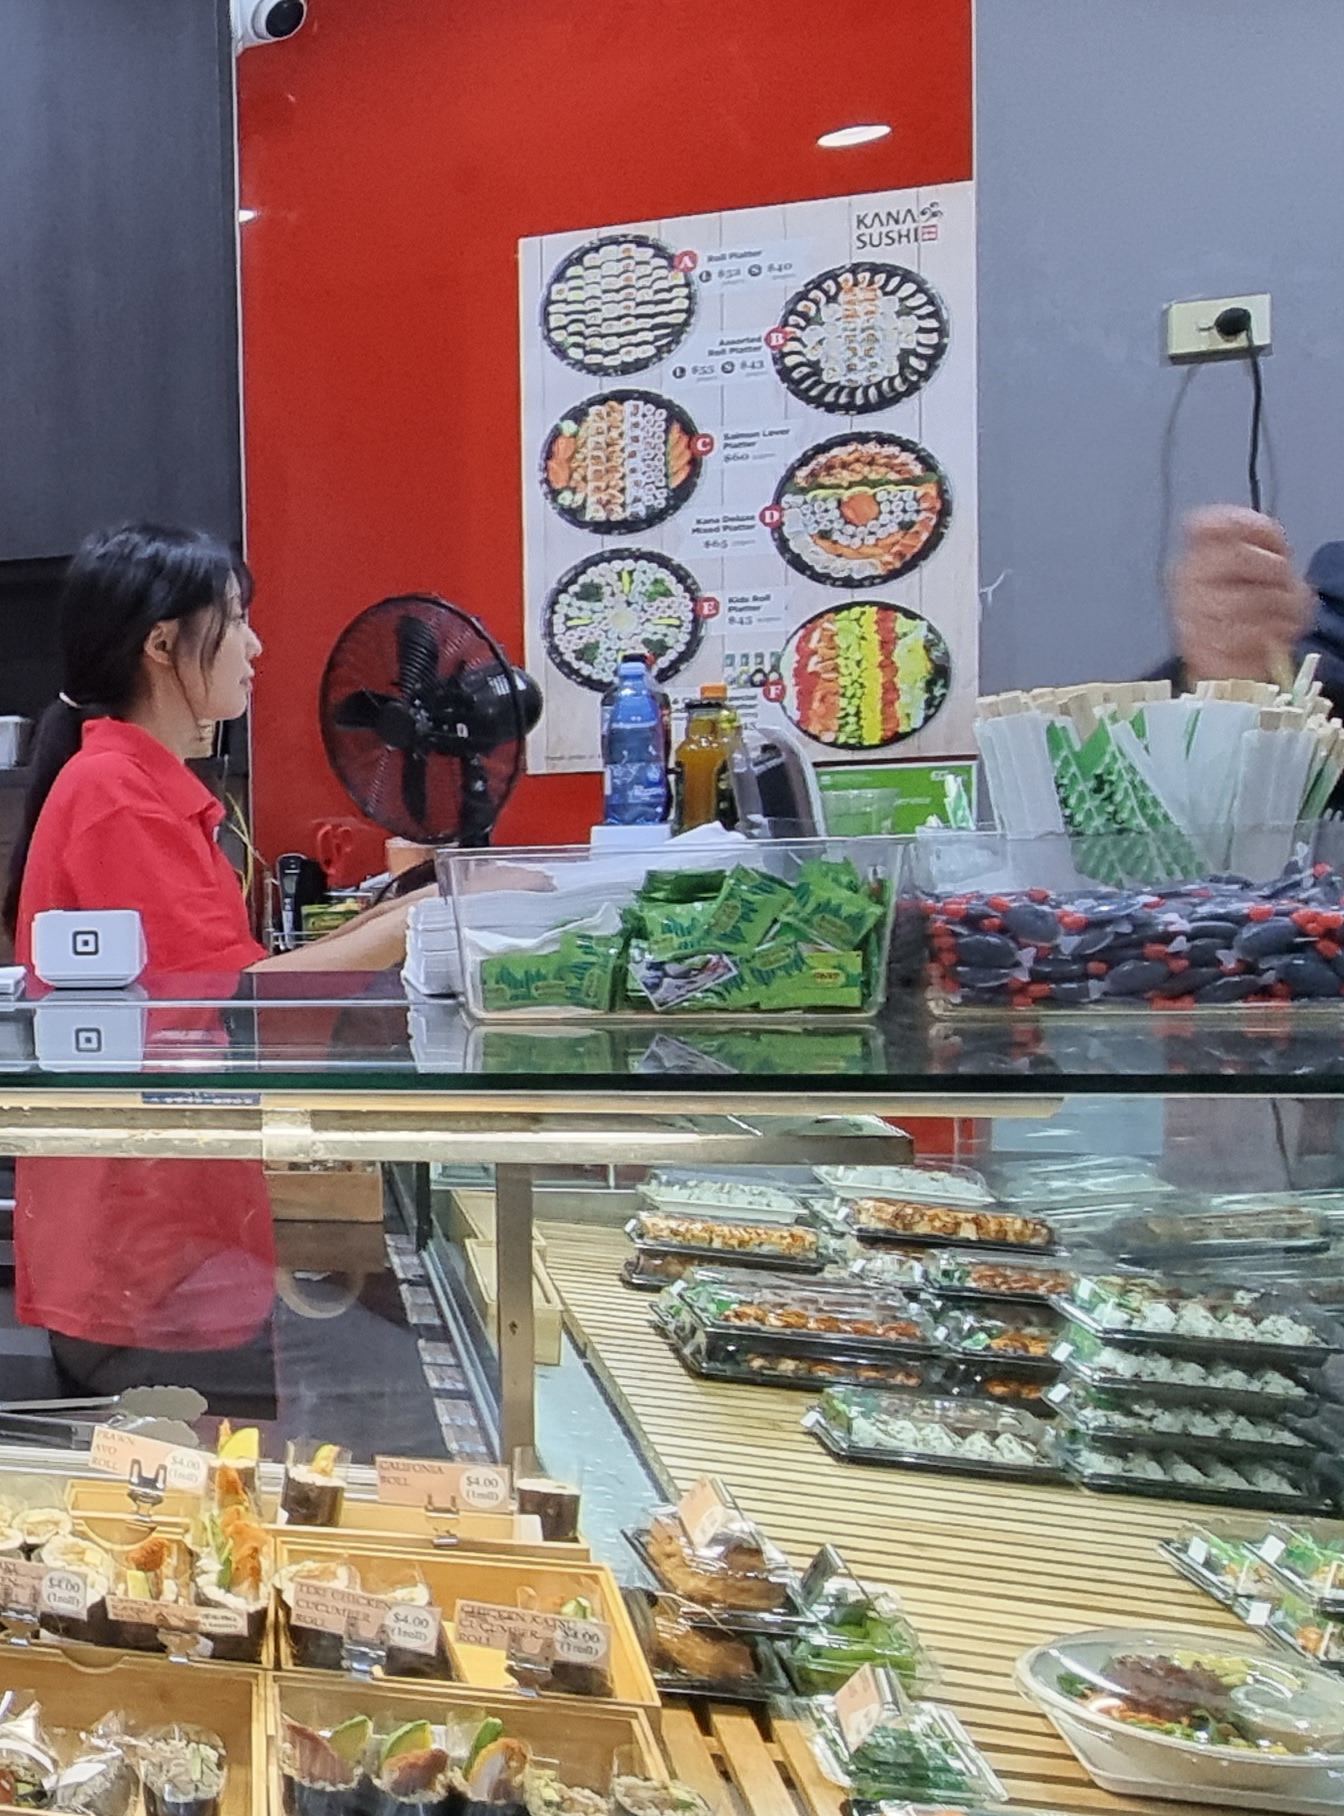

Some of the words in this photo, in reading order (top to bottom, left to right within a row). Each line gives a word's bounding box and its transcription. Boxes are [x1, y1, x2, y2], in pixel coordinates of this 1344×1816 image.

[856, 208, 917, 230] KANA
[856, 227, 919, 250] SUSHI
[466, 1475, 499, 1488] $4.00
[393, 1612, 430, 1629] $4.00
